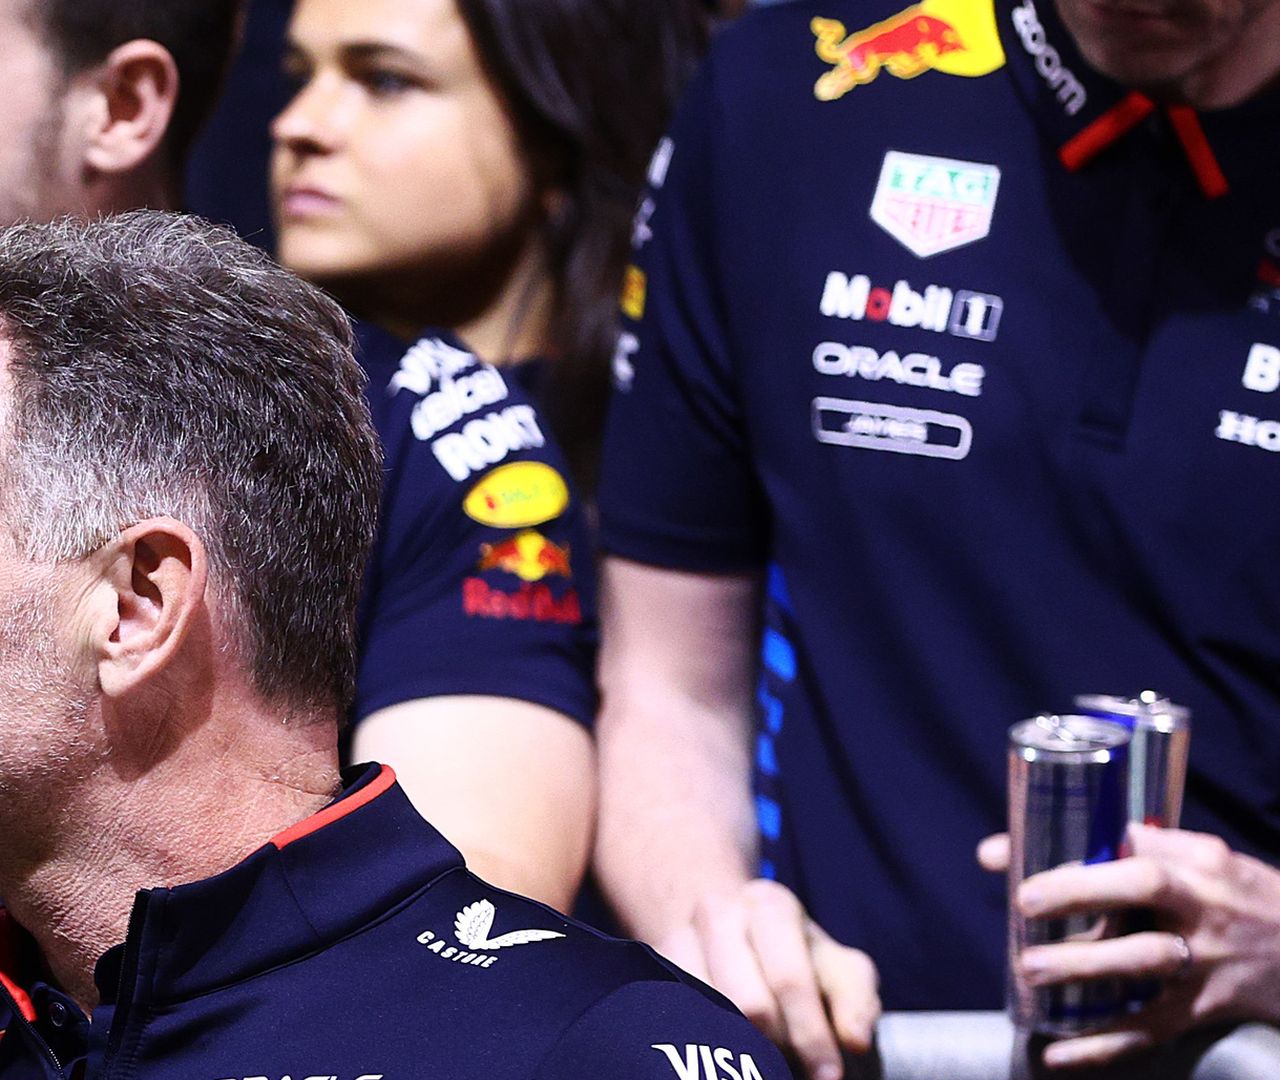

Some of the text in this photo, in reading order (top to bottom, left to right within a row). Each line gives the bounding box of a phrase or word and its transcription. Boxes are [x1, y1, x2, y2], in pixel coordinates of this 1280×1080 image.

[820, 271, 953, 332] Mobil
[813, 342, 986, 397] ORACLE
[415, 929, 499, 969] CASTORE
